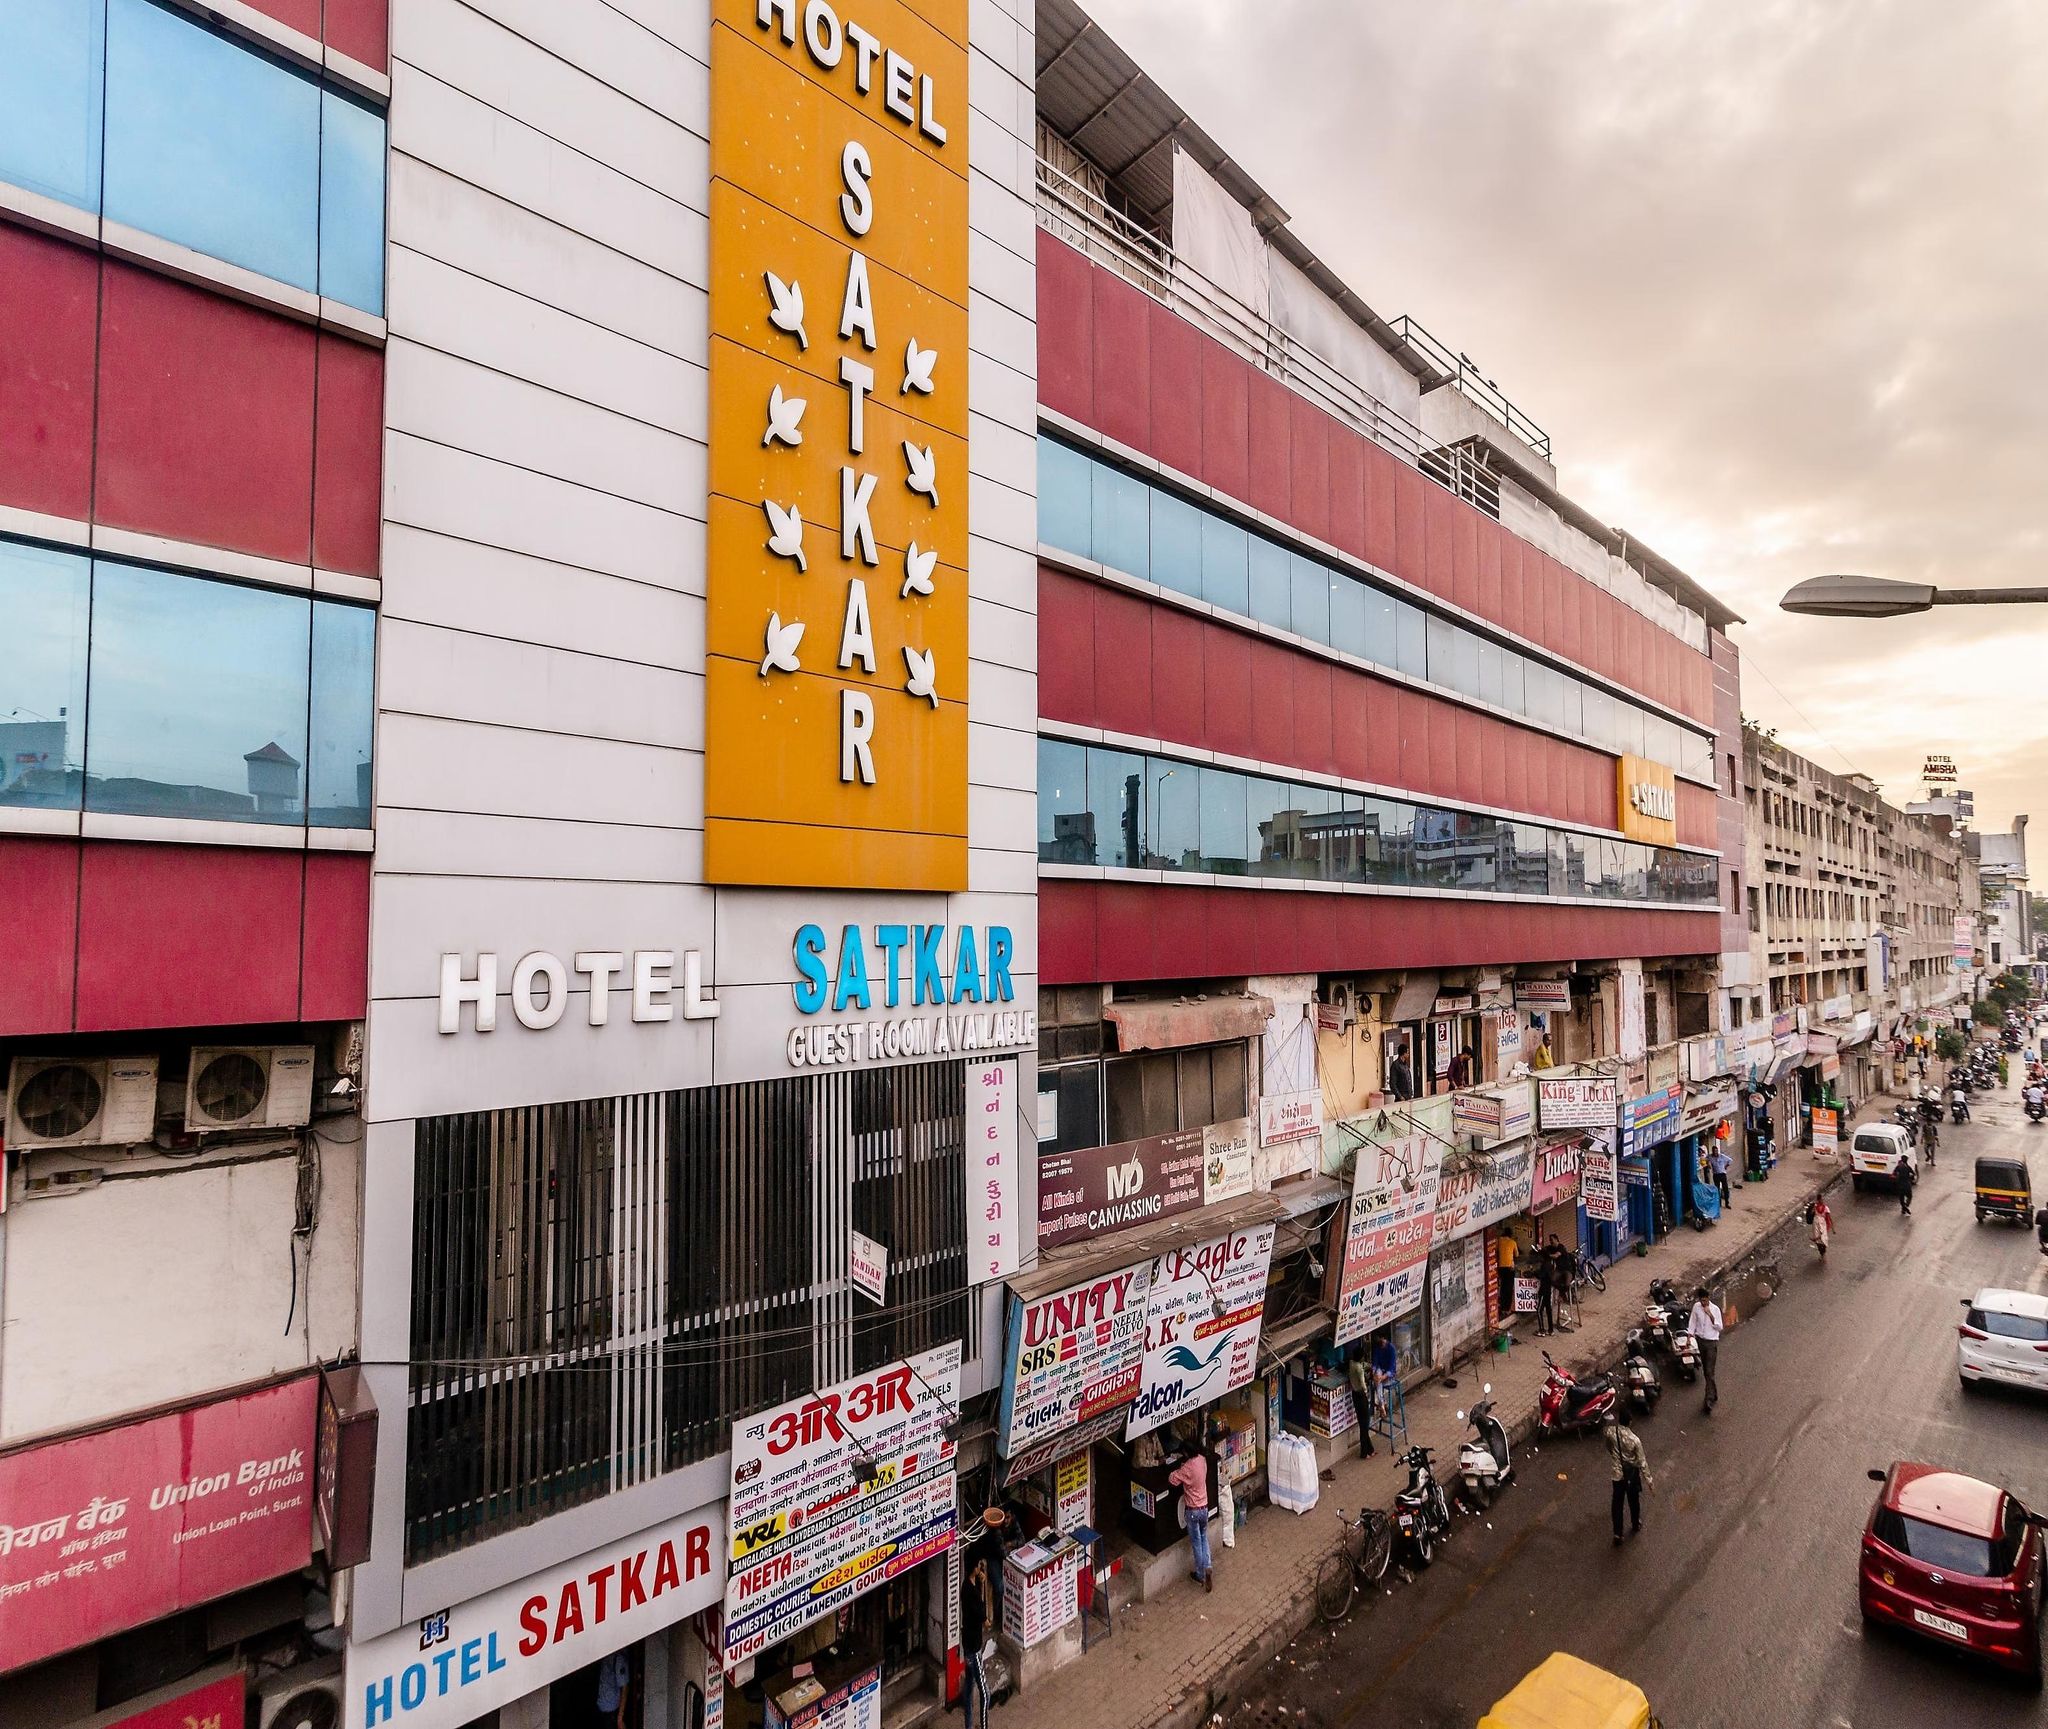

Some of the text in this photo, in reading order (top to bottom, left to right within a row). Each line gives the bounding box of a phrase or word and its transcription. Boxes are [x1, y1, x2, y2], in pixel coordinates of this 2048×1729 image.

[756, 0, 947, 147] HOTEL
[838, 140, 880, 785] SATKAR
[1923, 764, 1958, 774] AMISHA
[1640, 783, 1674, 821] SATKAR
[791, 923, 1015, 1015] SATKAR
[437, 949, 721, 1035] HOTEL
[788, 1010, 1037, 1068] GUEST ROOM AVAILABLE
[981, 1067, 1003, 1087] શ્રી
[1541, 1081, 1615, 1103] King LUCKY
[1209, 1142, 1231, 1155] Shree
[1233, 1137, 1247, 1150] Ram
[1377, 1137, 1427, 1184] RAJ
[1544, 1144, 1581, 1183] Lucky
[1586, 1156, 1610, 1171] King
[1041, 1187, 1083, 1211] All Kinds of
[1088, 1194, 1161, 1229] CANVASSING
[1354, 1197, 1373, 1217] SRS
[1166, 1234, 1248, 1284] Eagle
[1025, 1273, 1132, 1346] UNITY
[1113, 1309, 1142, 1329] NEETA
[1112, 1319, 1143, 1339] VOLVO
[1233, 1335, 1256, 1351] Bombay
[1020, 1342, 1055, 1375] SRS
[1229, 1359, 1249, 1376] Panvel
[1231, 1351, 1247, 1364] Pune
[917, 1382, 951, 1403] TRAVELS
[1227, 1370, 1254, 1389] Kolhapur
[1129, 1378, 1182, 1423] Falcon
[1150, 1395, 1200, 1426] Travels Agency
[739, 1459, 758, 1472] VOLVO
[770, 1459, 807, 1485] अमरावती
[1010, 1441, 1060, 1476] UNITY
[149, 1448, 304, 1511] Union Bank
[248, 1470, 304, 1499] of India
[770, 1480, 797, 1498] जालना
[173, 1495, 304, 1546] Union Loan Point, Surat.
[732, 1545, 772, 1573] BANGALORE
[773, 1535, 793, 1553] HUBLI
[794, 1518, 830, 1543] HYDERABAD
[831, 1503, 862, 1525] SHOLAPUR
[862, 1497, 874, 1510] GOA
[919, 1469, 933, 1483] PUNE
[934, 1459, 954, 1476] MUMBAI
[736, 1518, 780, 1548] VRL
[793, 1535, 826, 1557] અમદાવાદ
[729, 1517, 951, 1642] DOMESTIC COURIER PARCEL SERVICE
[739, 1552, 791, 1599] NEETA
[820, 1548, 888, 1593] પરદેશ પાર્સલ
[1026, 1556, 1064, 1588] UNITY
[730, 1594, 766, 1619] ભાવનગર
[808, 1558, 834, 1578] રાજકોટ
[805, 1567, 884, 1619] MAHENDRA GOUR
[365, 1524, 712, 1729] HOTEL SATKAR
